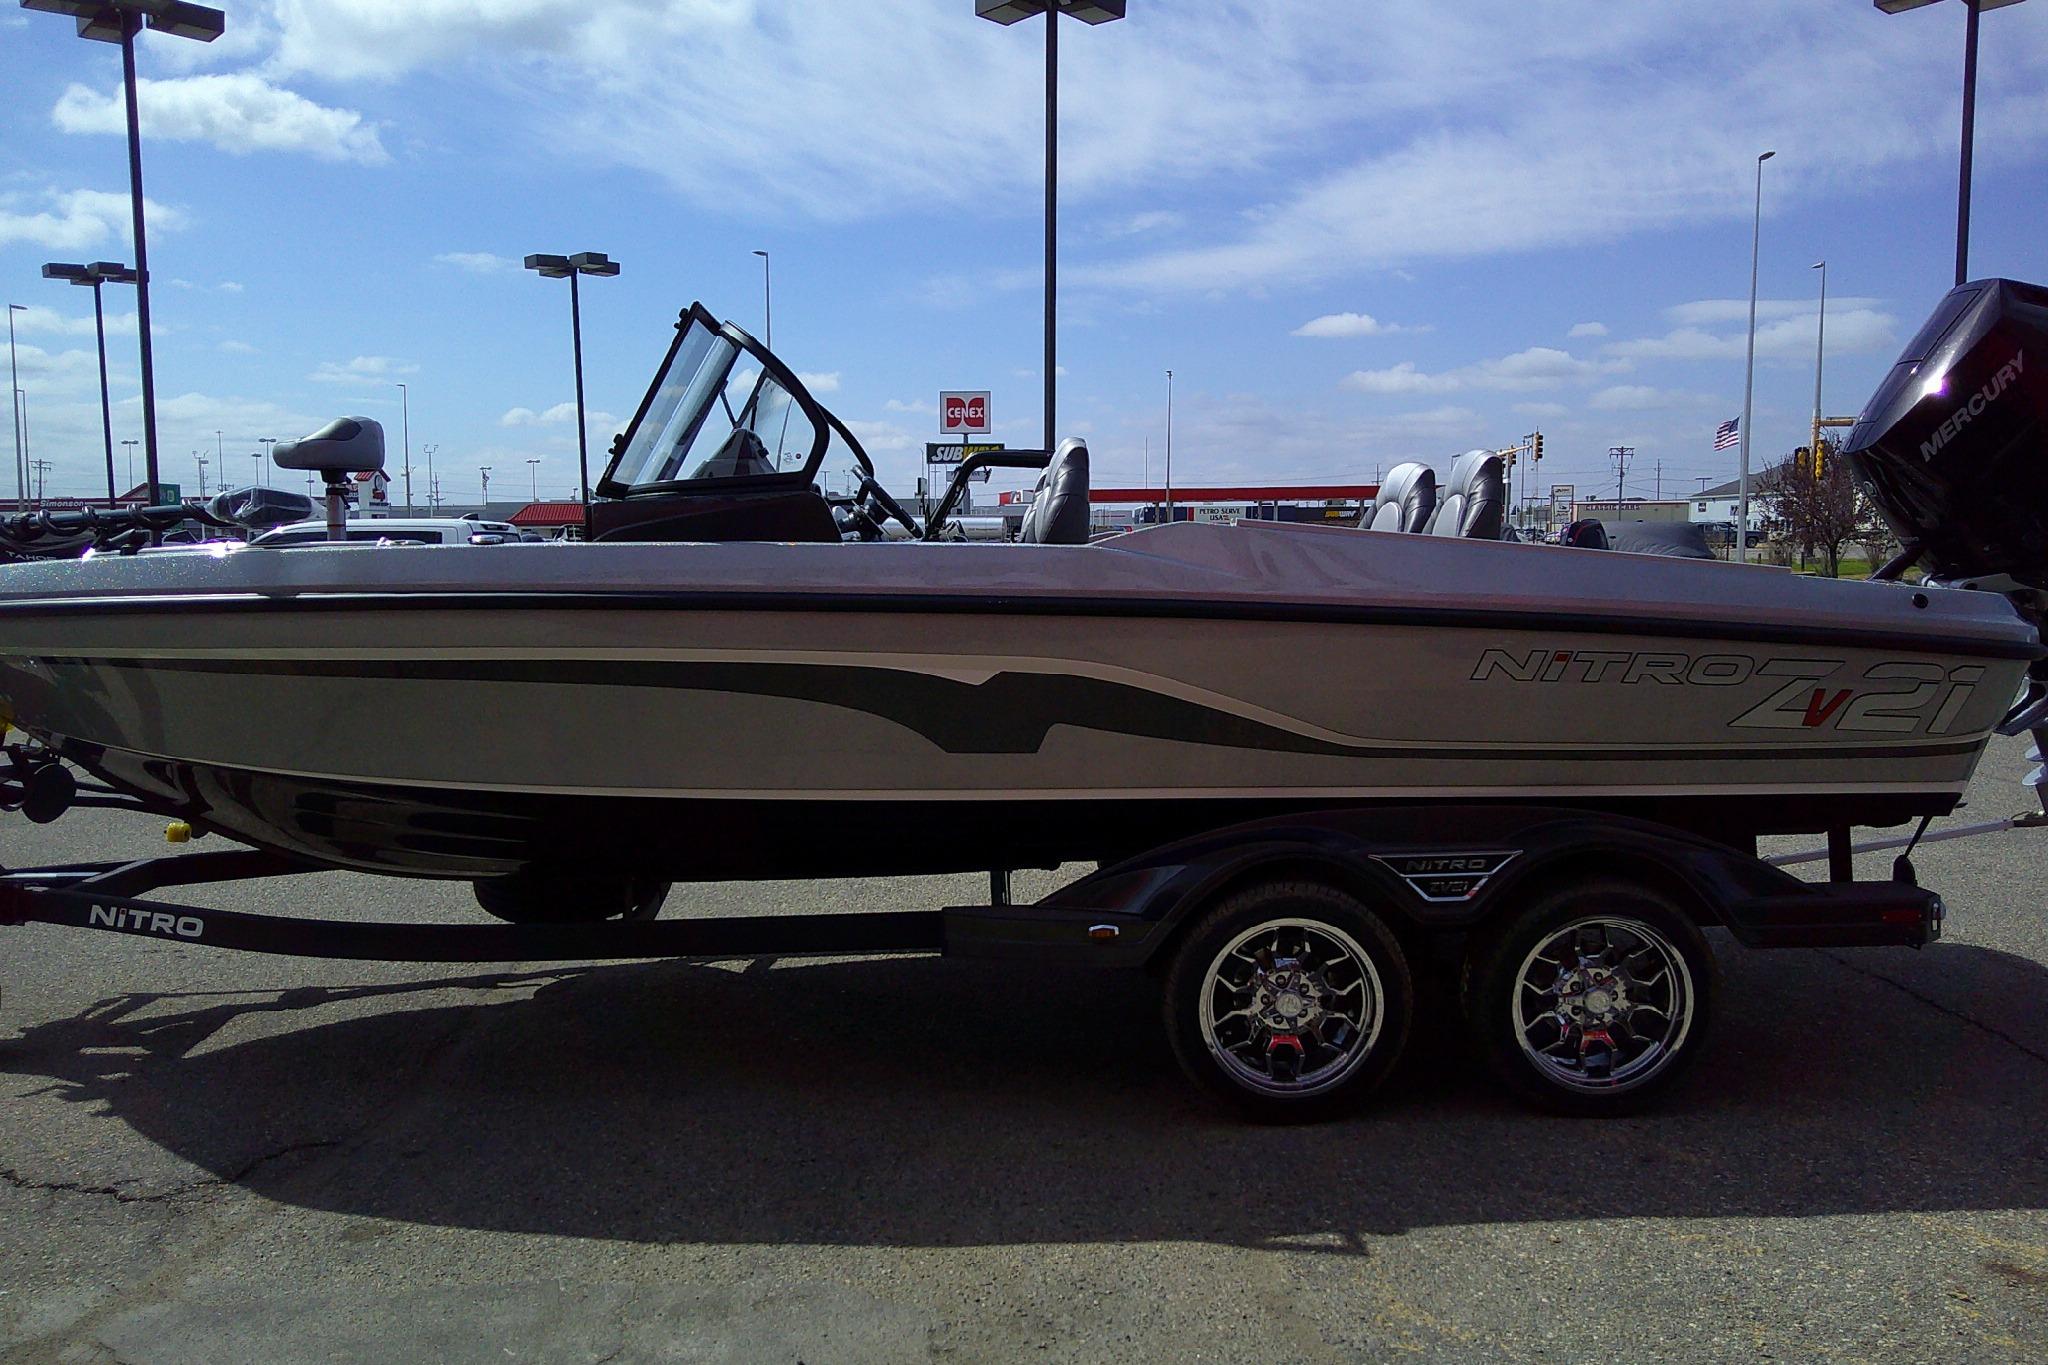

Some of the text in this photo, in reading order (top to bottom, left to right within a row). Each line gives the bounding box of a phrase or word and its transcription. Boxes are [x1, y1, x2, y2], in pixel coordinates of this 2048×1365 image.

[947, 407, 984, 418] CENEX
[1919, 349, 2024, 463] MERCURY
[931, 446, 1000, 462] SUBW
[1406, 858, 1488, 872] NITRO
